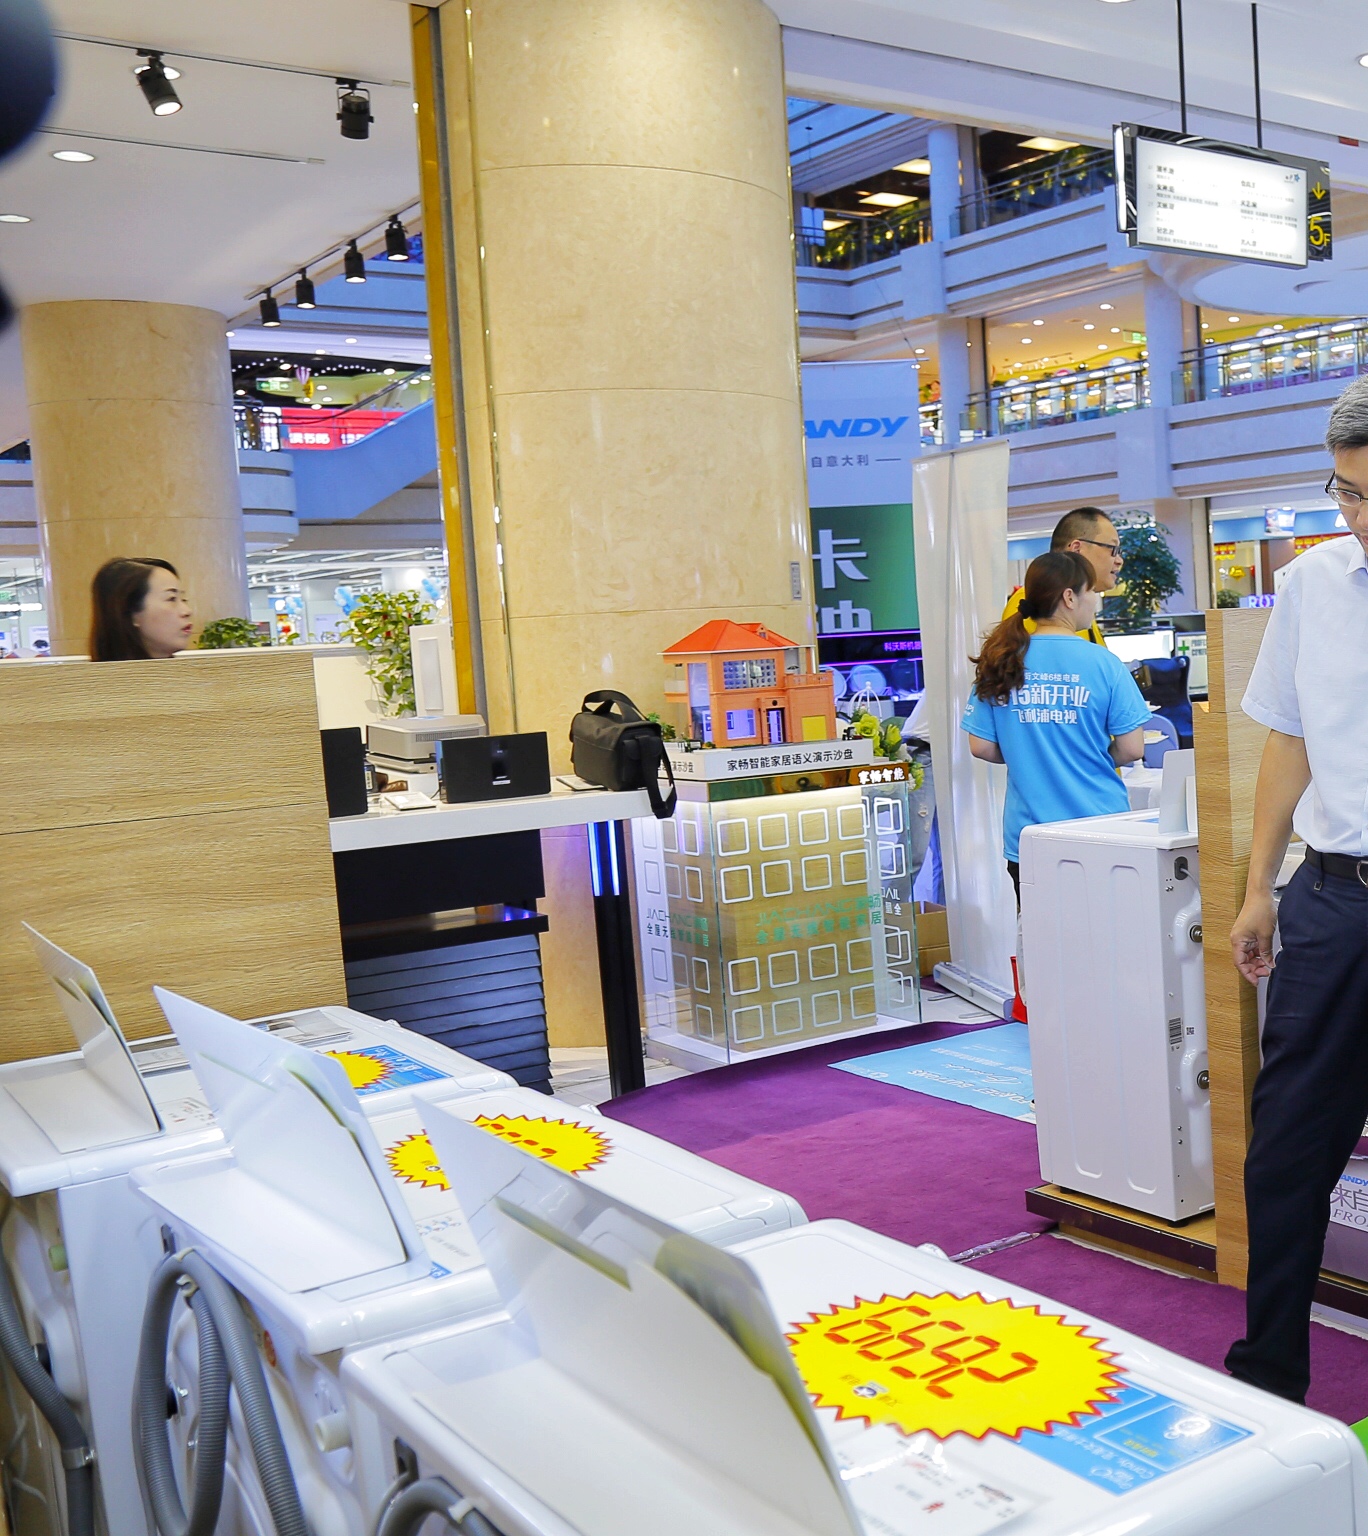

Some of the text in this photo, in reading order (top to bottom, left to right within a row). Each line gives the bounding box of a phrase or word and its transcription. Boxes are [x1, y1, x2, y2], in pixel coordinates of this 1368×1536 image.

[1309, 216, 1331, 246] 5F
[811, 454, 869, 468] 自意大利
[1011, 708, 1078, 725] 飞利浦电视
[726, 748, 854, 772] 家畅智能家居语义演示沙盘
[824, 1305, 1039, 1399] 2699
